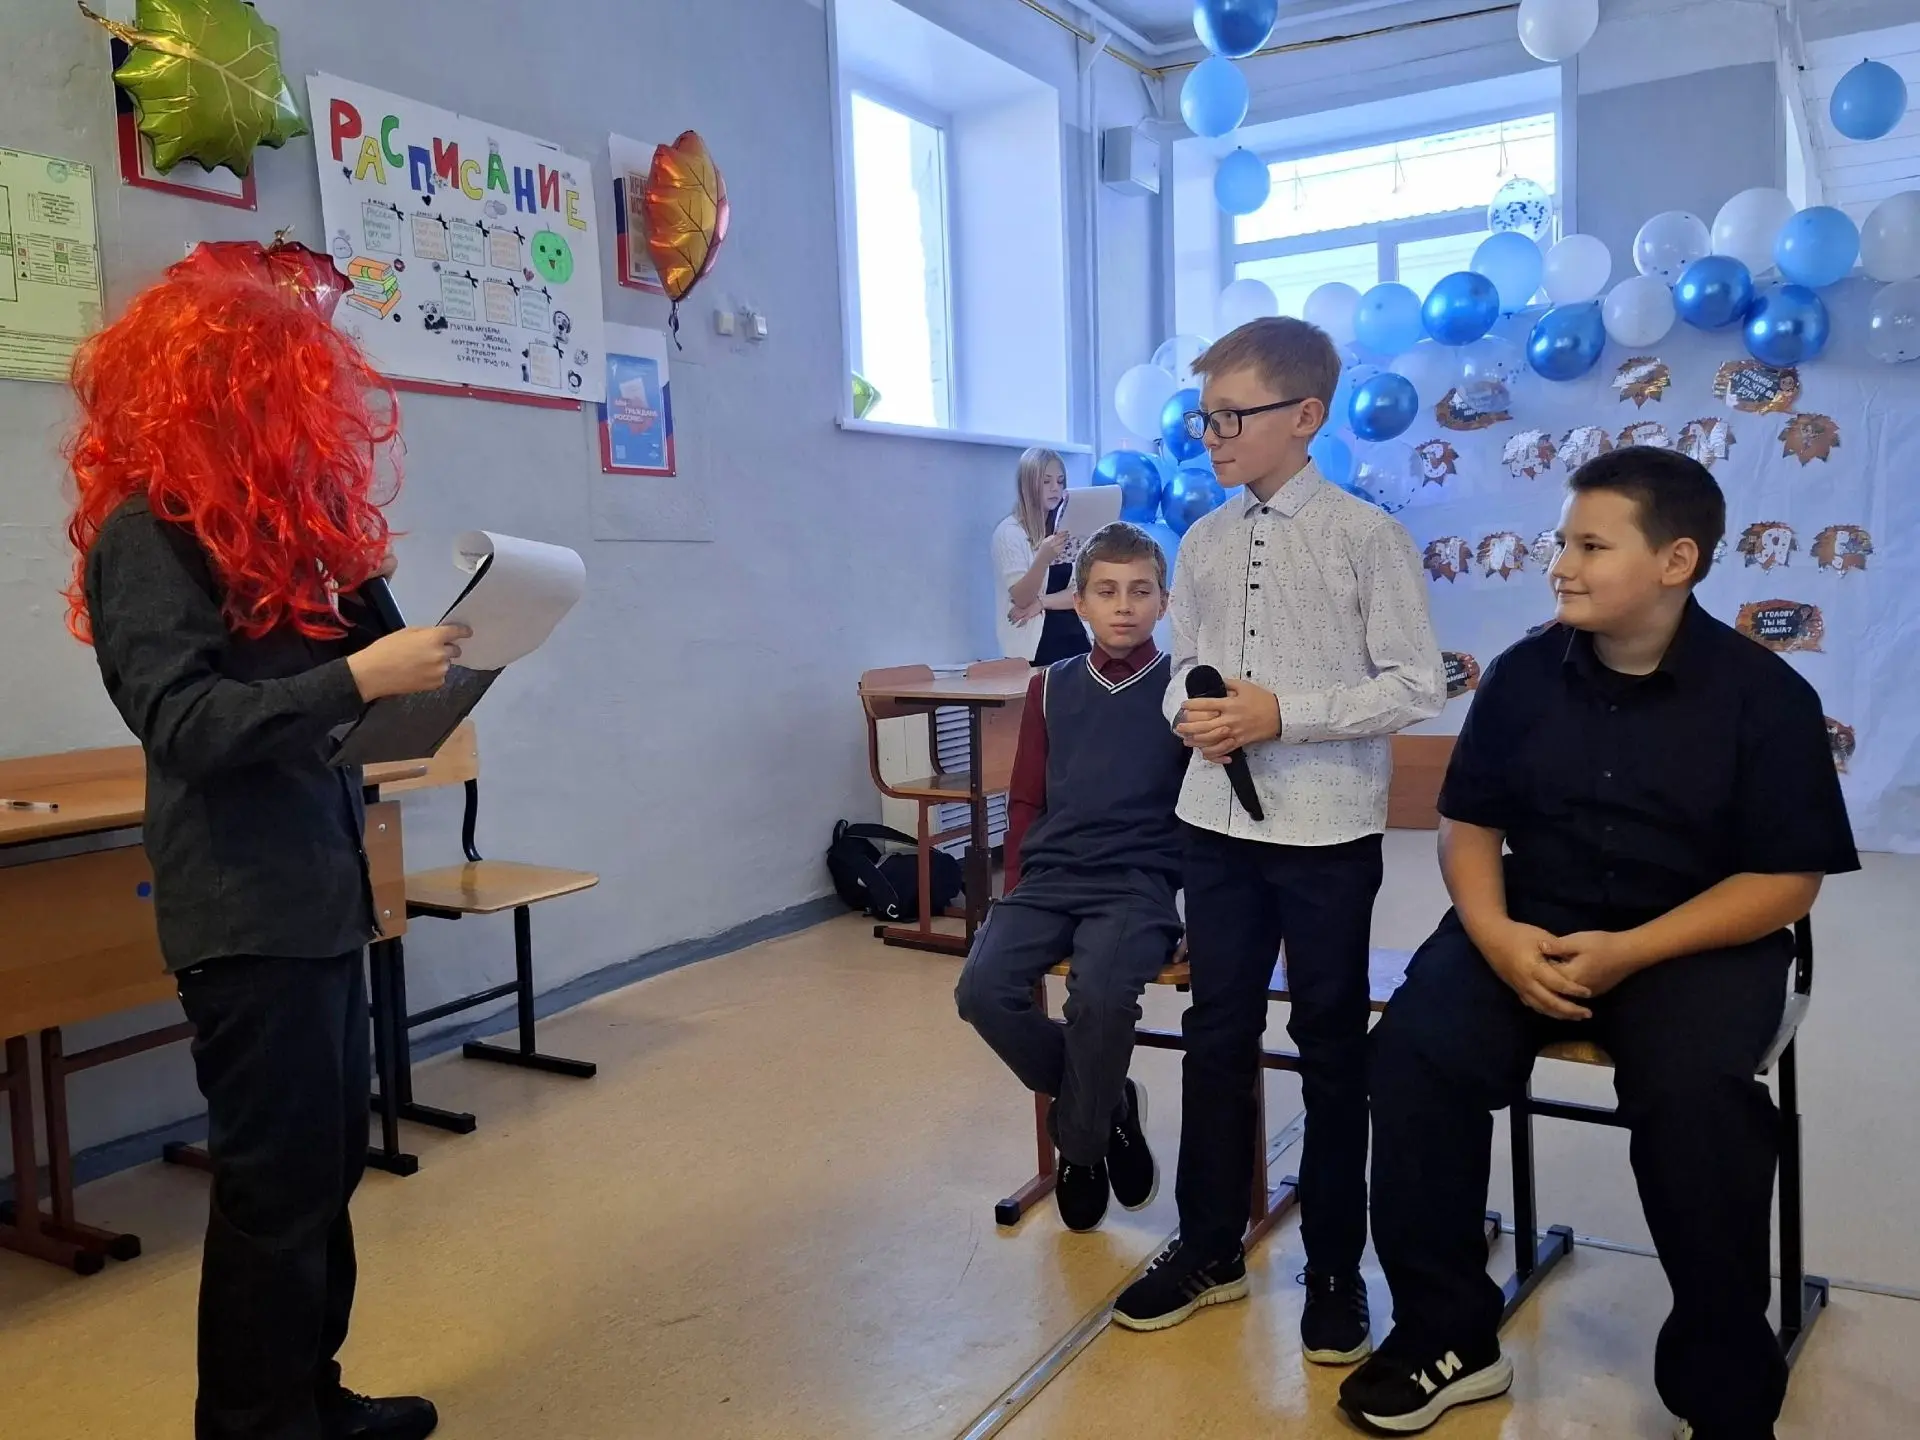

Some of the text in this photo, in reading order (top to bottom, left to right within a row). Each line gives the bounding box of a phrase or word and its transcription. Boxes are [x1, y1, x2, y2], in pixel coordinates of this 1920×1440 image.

[330, 98, 587, 231] РАСПИСАНИЕ
[1742, 369, 1774, 388] СПАСИБО
[1757, 610, 1795, 619] А ГОЛОВУ
[1776, 618, 1787, 626] НЕ
[1760, 626, 1793, 635] ЗАБЫЛ?
